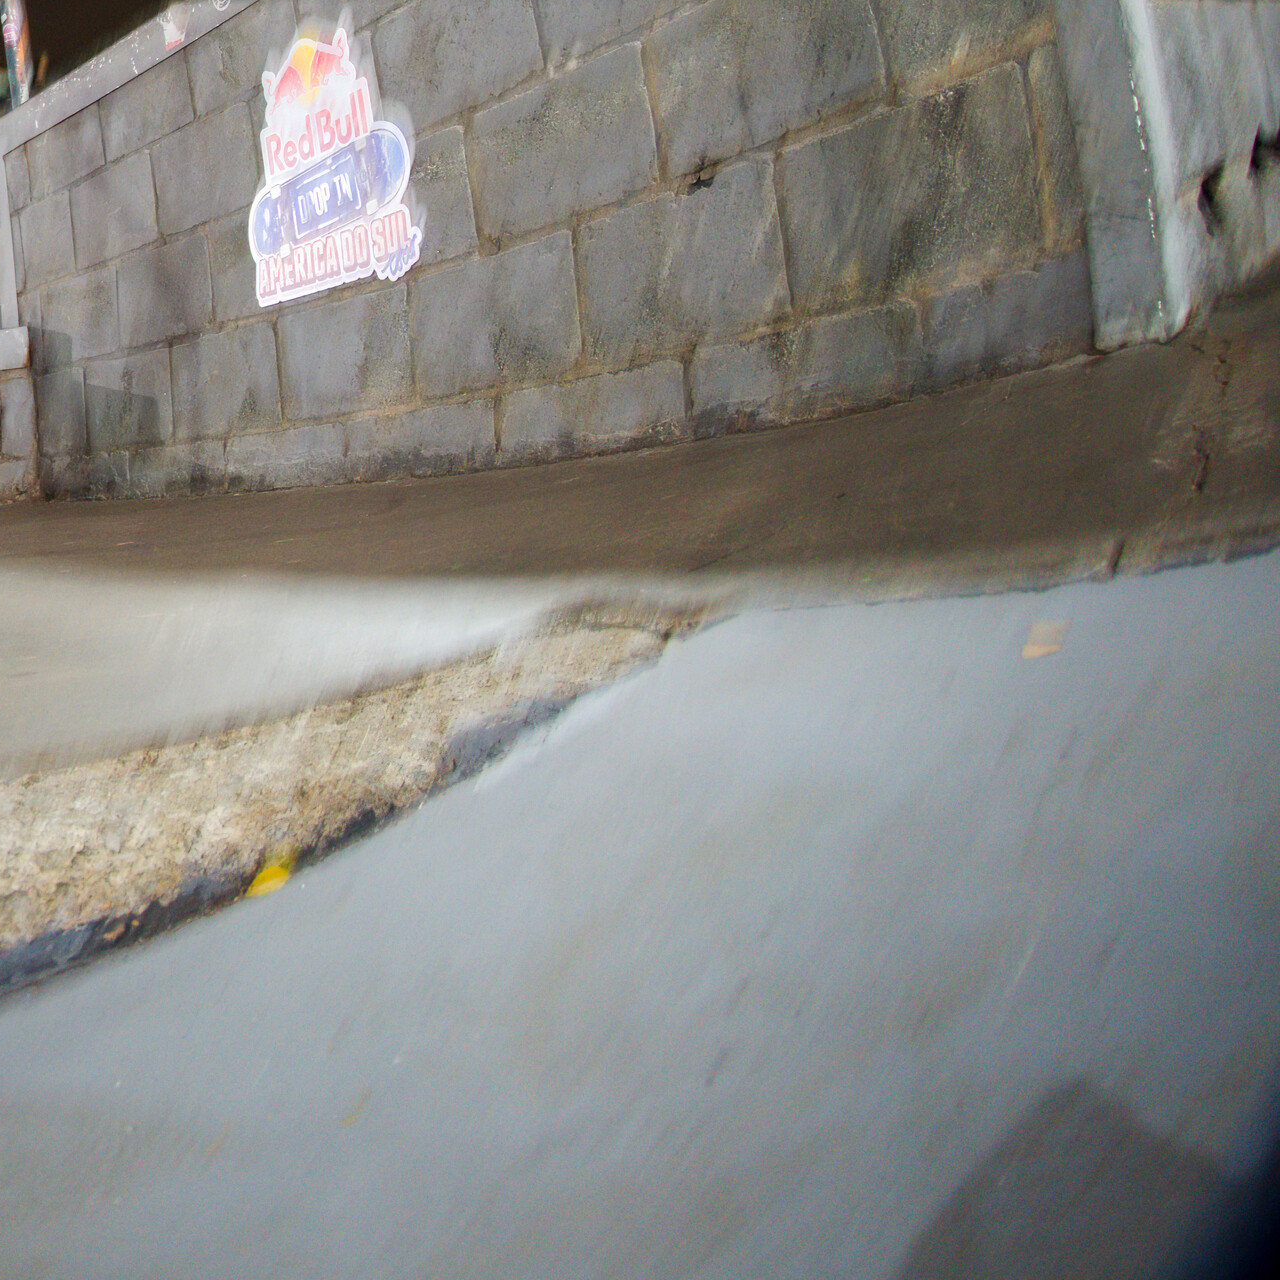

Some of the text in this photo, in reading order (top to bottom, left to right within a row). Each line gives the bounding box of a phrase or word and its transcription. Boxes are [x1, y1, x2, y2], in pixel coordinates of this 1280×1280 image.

[264, 88, 369, 174] Red Bull
[340, 224, 371, 271] DO
[370, 210, 408, 261] SUL
